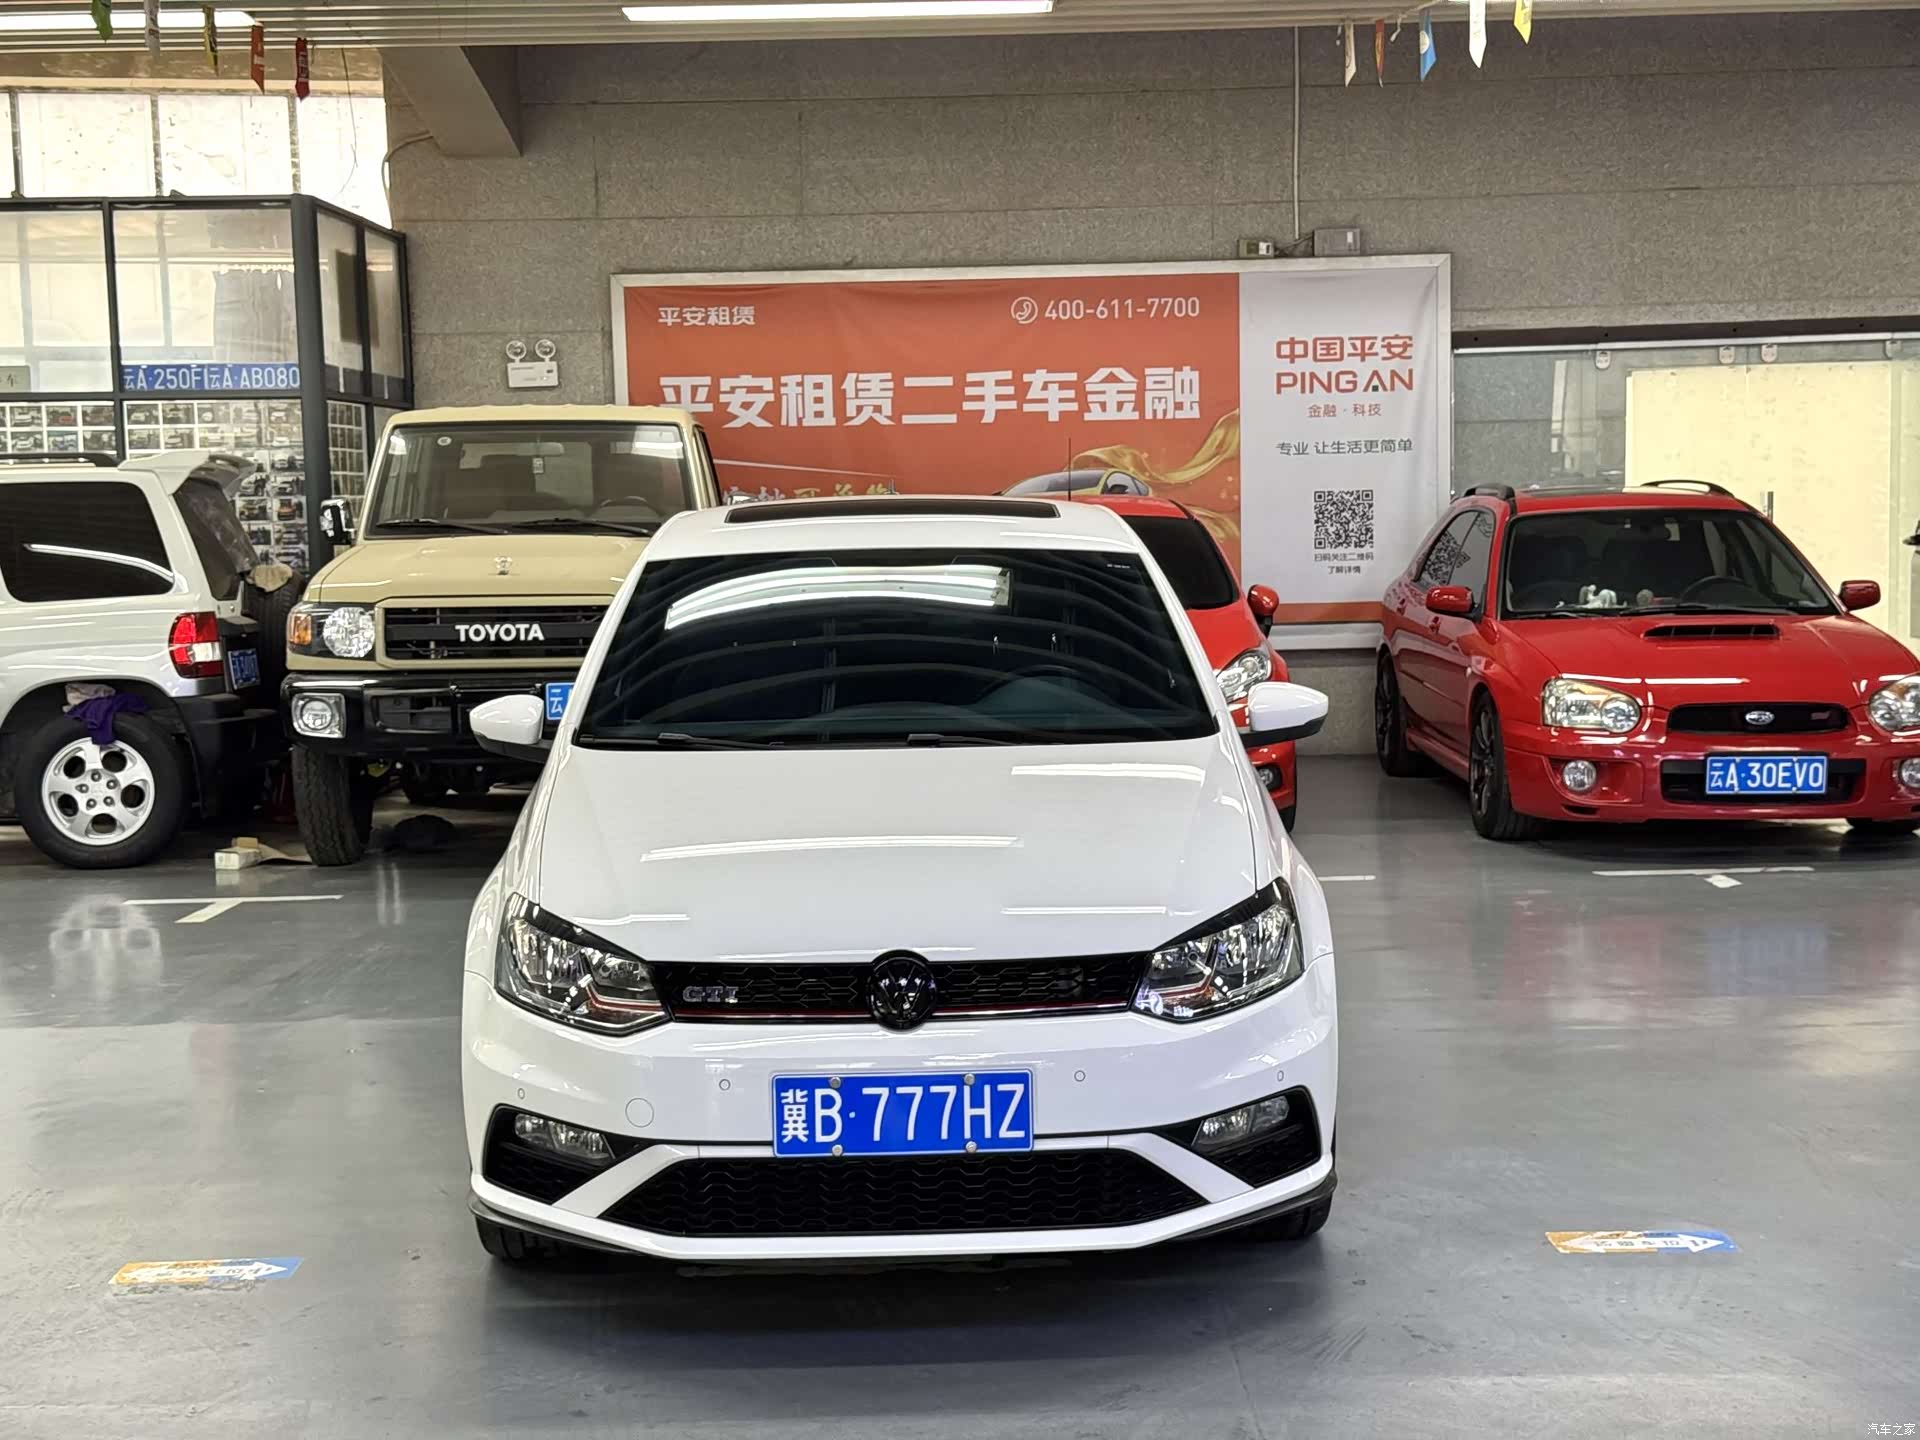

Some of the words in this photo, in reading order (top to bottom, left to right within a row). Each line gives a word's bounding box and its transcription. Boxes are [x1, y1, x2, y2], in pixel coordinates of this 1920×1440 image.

[658, 305, 756, 327] 平安租赁
[1044, 297, 1200, 321] 400-611-7700
[1275, 334, 1414, 364] 中国平安
[659, 367, 1201, 429] 平安租赁二手车金融
[454, 623, 545, 642] TOYOTA
[682, 985, 739, 1003] GTI
